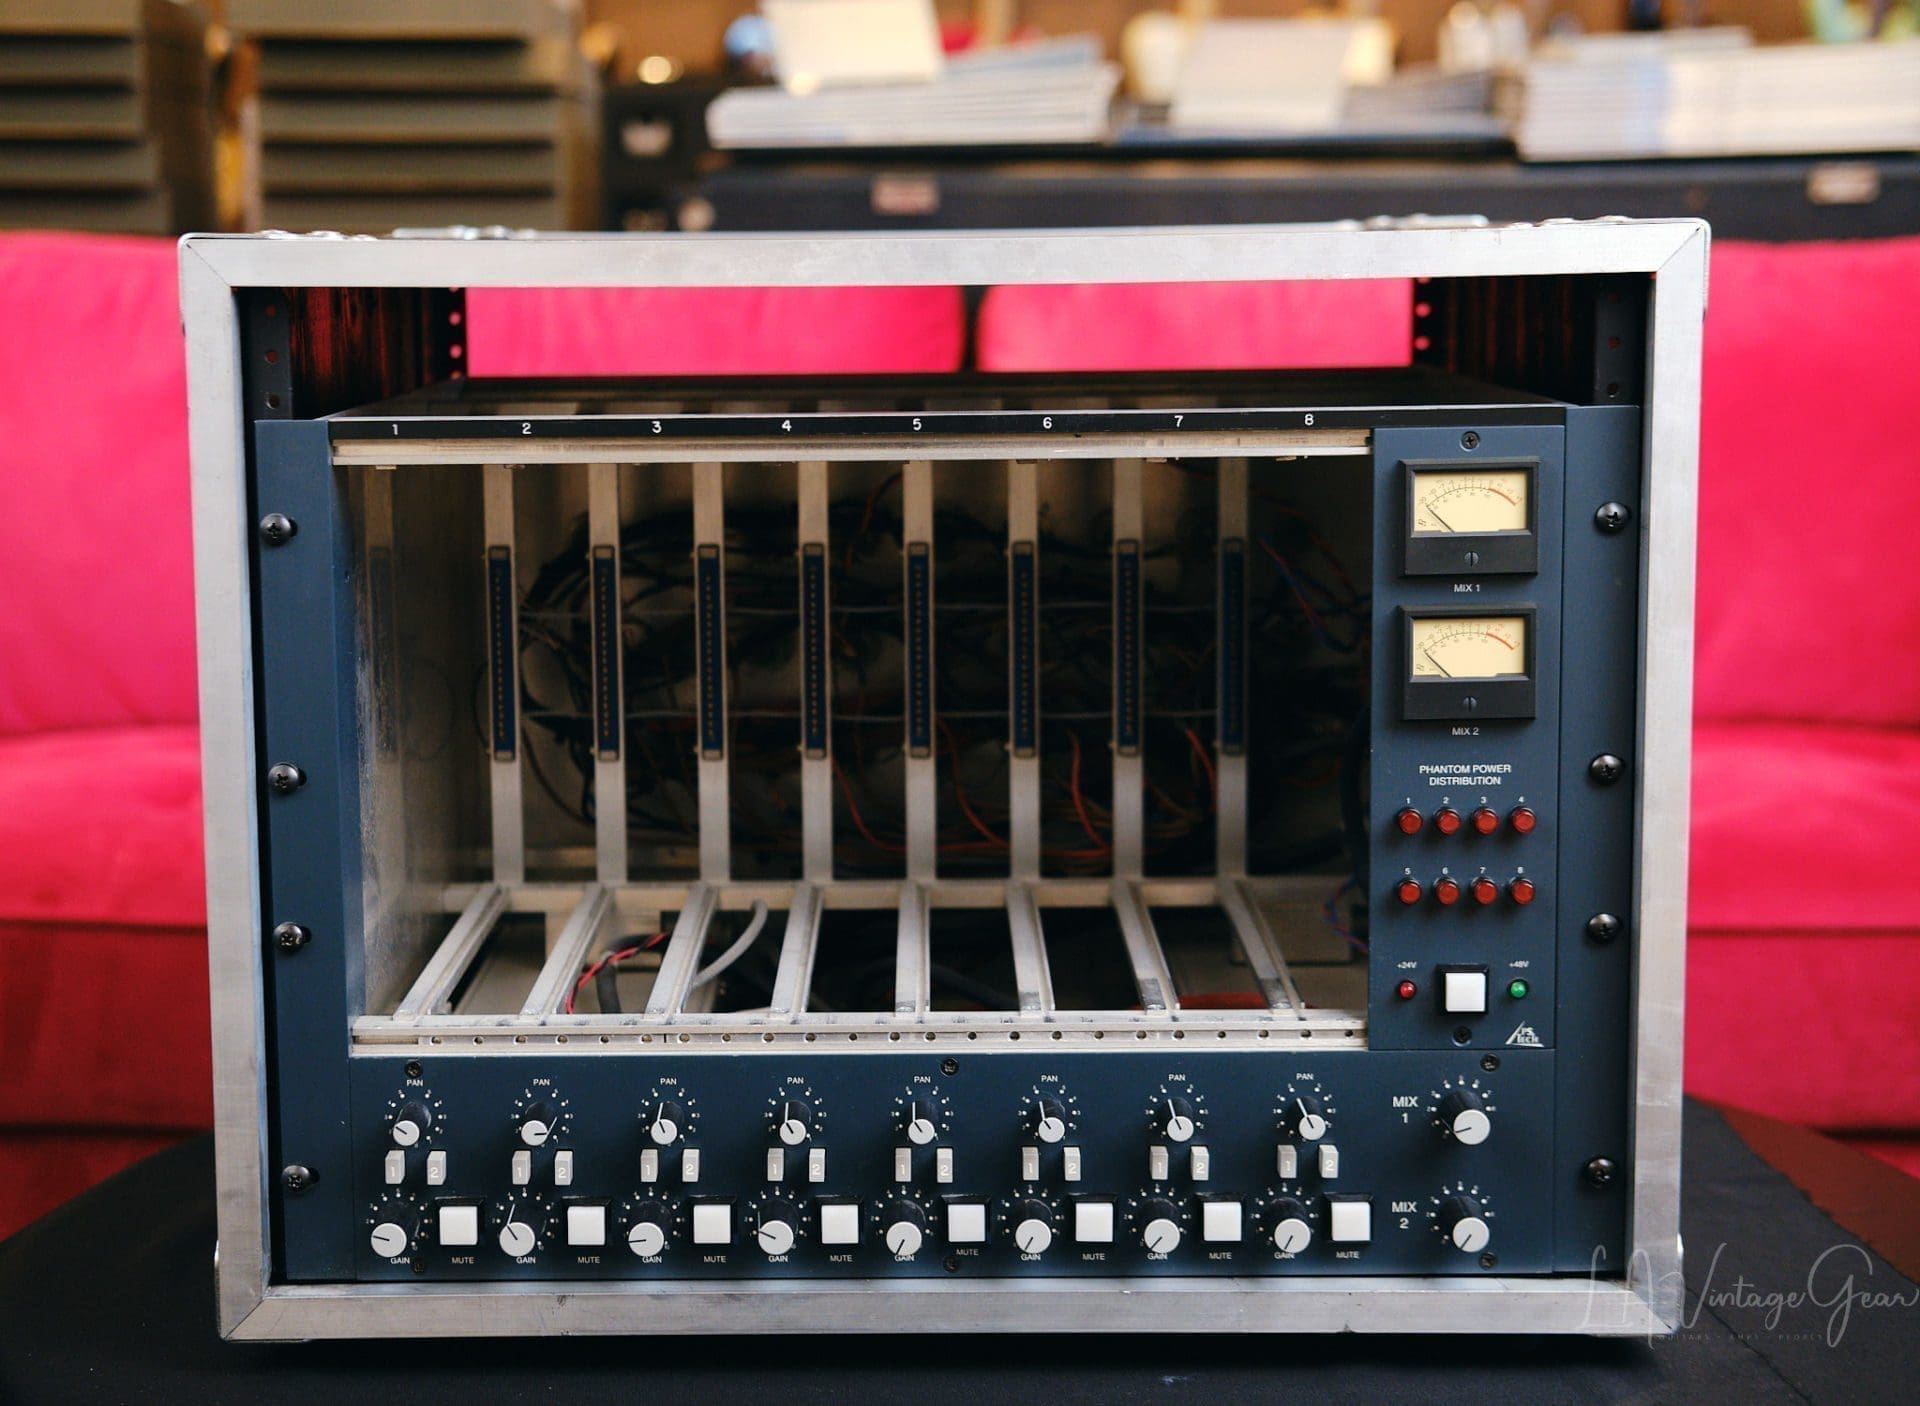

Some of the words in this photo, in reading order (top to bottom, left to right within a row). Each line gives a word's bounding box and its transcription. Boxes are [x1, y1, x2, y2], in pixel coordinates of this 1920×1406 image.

[912, 418, 922, 431] 5
[1042, 416, 1053, 429] 6
[1174, 415, 1184, 428] 7
[1304, 414, 1314, 426] 8
[392, 424, 398, 435] 1
[522, 422, 532, 434] 2
[652, 421, 662, 433] 3
[782, 420, 792, 432] 4
[1454, 584, 1472, 593] MIX
[1476, 584, 1481, 592] 1
[1452, 727, 1471, 736] MIX
[1472, 727, 1480, 736] 2
[1419, 765, 1470, 774] PHANTOM
[1472, 764, 1512, 774] POWER
[1429, 776, 1502, 786] DISTRIBUTION
[1481, 796, 1487, 804] 3
[1480, 866, 1486, 874] 7
[1518, 866, 1524, 874] 8
[1508, 960, 1530, 968] +48V
[1392, 1096, 1418, 1108] MIX
[1402, 1112, 1408, 1124] 1
[391, 1166, 396, 1177] 1
[646, 1164, 650, 1176] 1
[686, 1164, 694, 1175] 2
[772, 1164, 777, 1175] 1
[812, 1164, 822, 1176] 2
[901, 1164, 906, 1175] 1
[940, 1165, 950, 1176] 2
[1028, 1162, 1033, 1174] 1
[1068, 1162, 1077, 1174] 2
[1158, 1162, 1162, 1173] 1
[1196, 1162, 1206, 1174] 2
[1286, 1160, 1291, 1172] 1
[1326, 1160, 1335, 1172] 2
[430, 1167, 440, 1179] 2
[518, 1167, 522, 1178] 1
[558, 1168, 568, 1179] 2
[1392, 1202, 1418, 1212] MIX
[1400, 1218, 1409, 1230] 2
[956, 1248, 980, 1256] MUTE
[1082, 1252, 1106, 1261] MUTE
[1147, 1252, 1168, 1260] GAIN
[1209, 1252, 1233, 1260] MUTE
[1274, 1252, 1295, 1260] GAIN
[1336, 1250, 1361, 1260] MUTE
[578, 1256, 601, 1264] MUTE
[642, 1256, 663, 1264] GAIN
[704, 1256, 727, 1264] MUTE
[768, 1256, 789, 1264] GAIN
[830, 1254, 854, 1263] MUTE
[894, 1254, 914, 1262] GAIN
[1020, 1254, 1041, 1262] GAIN
